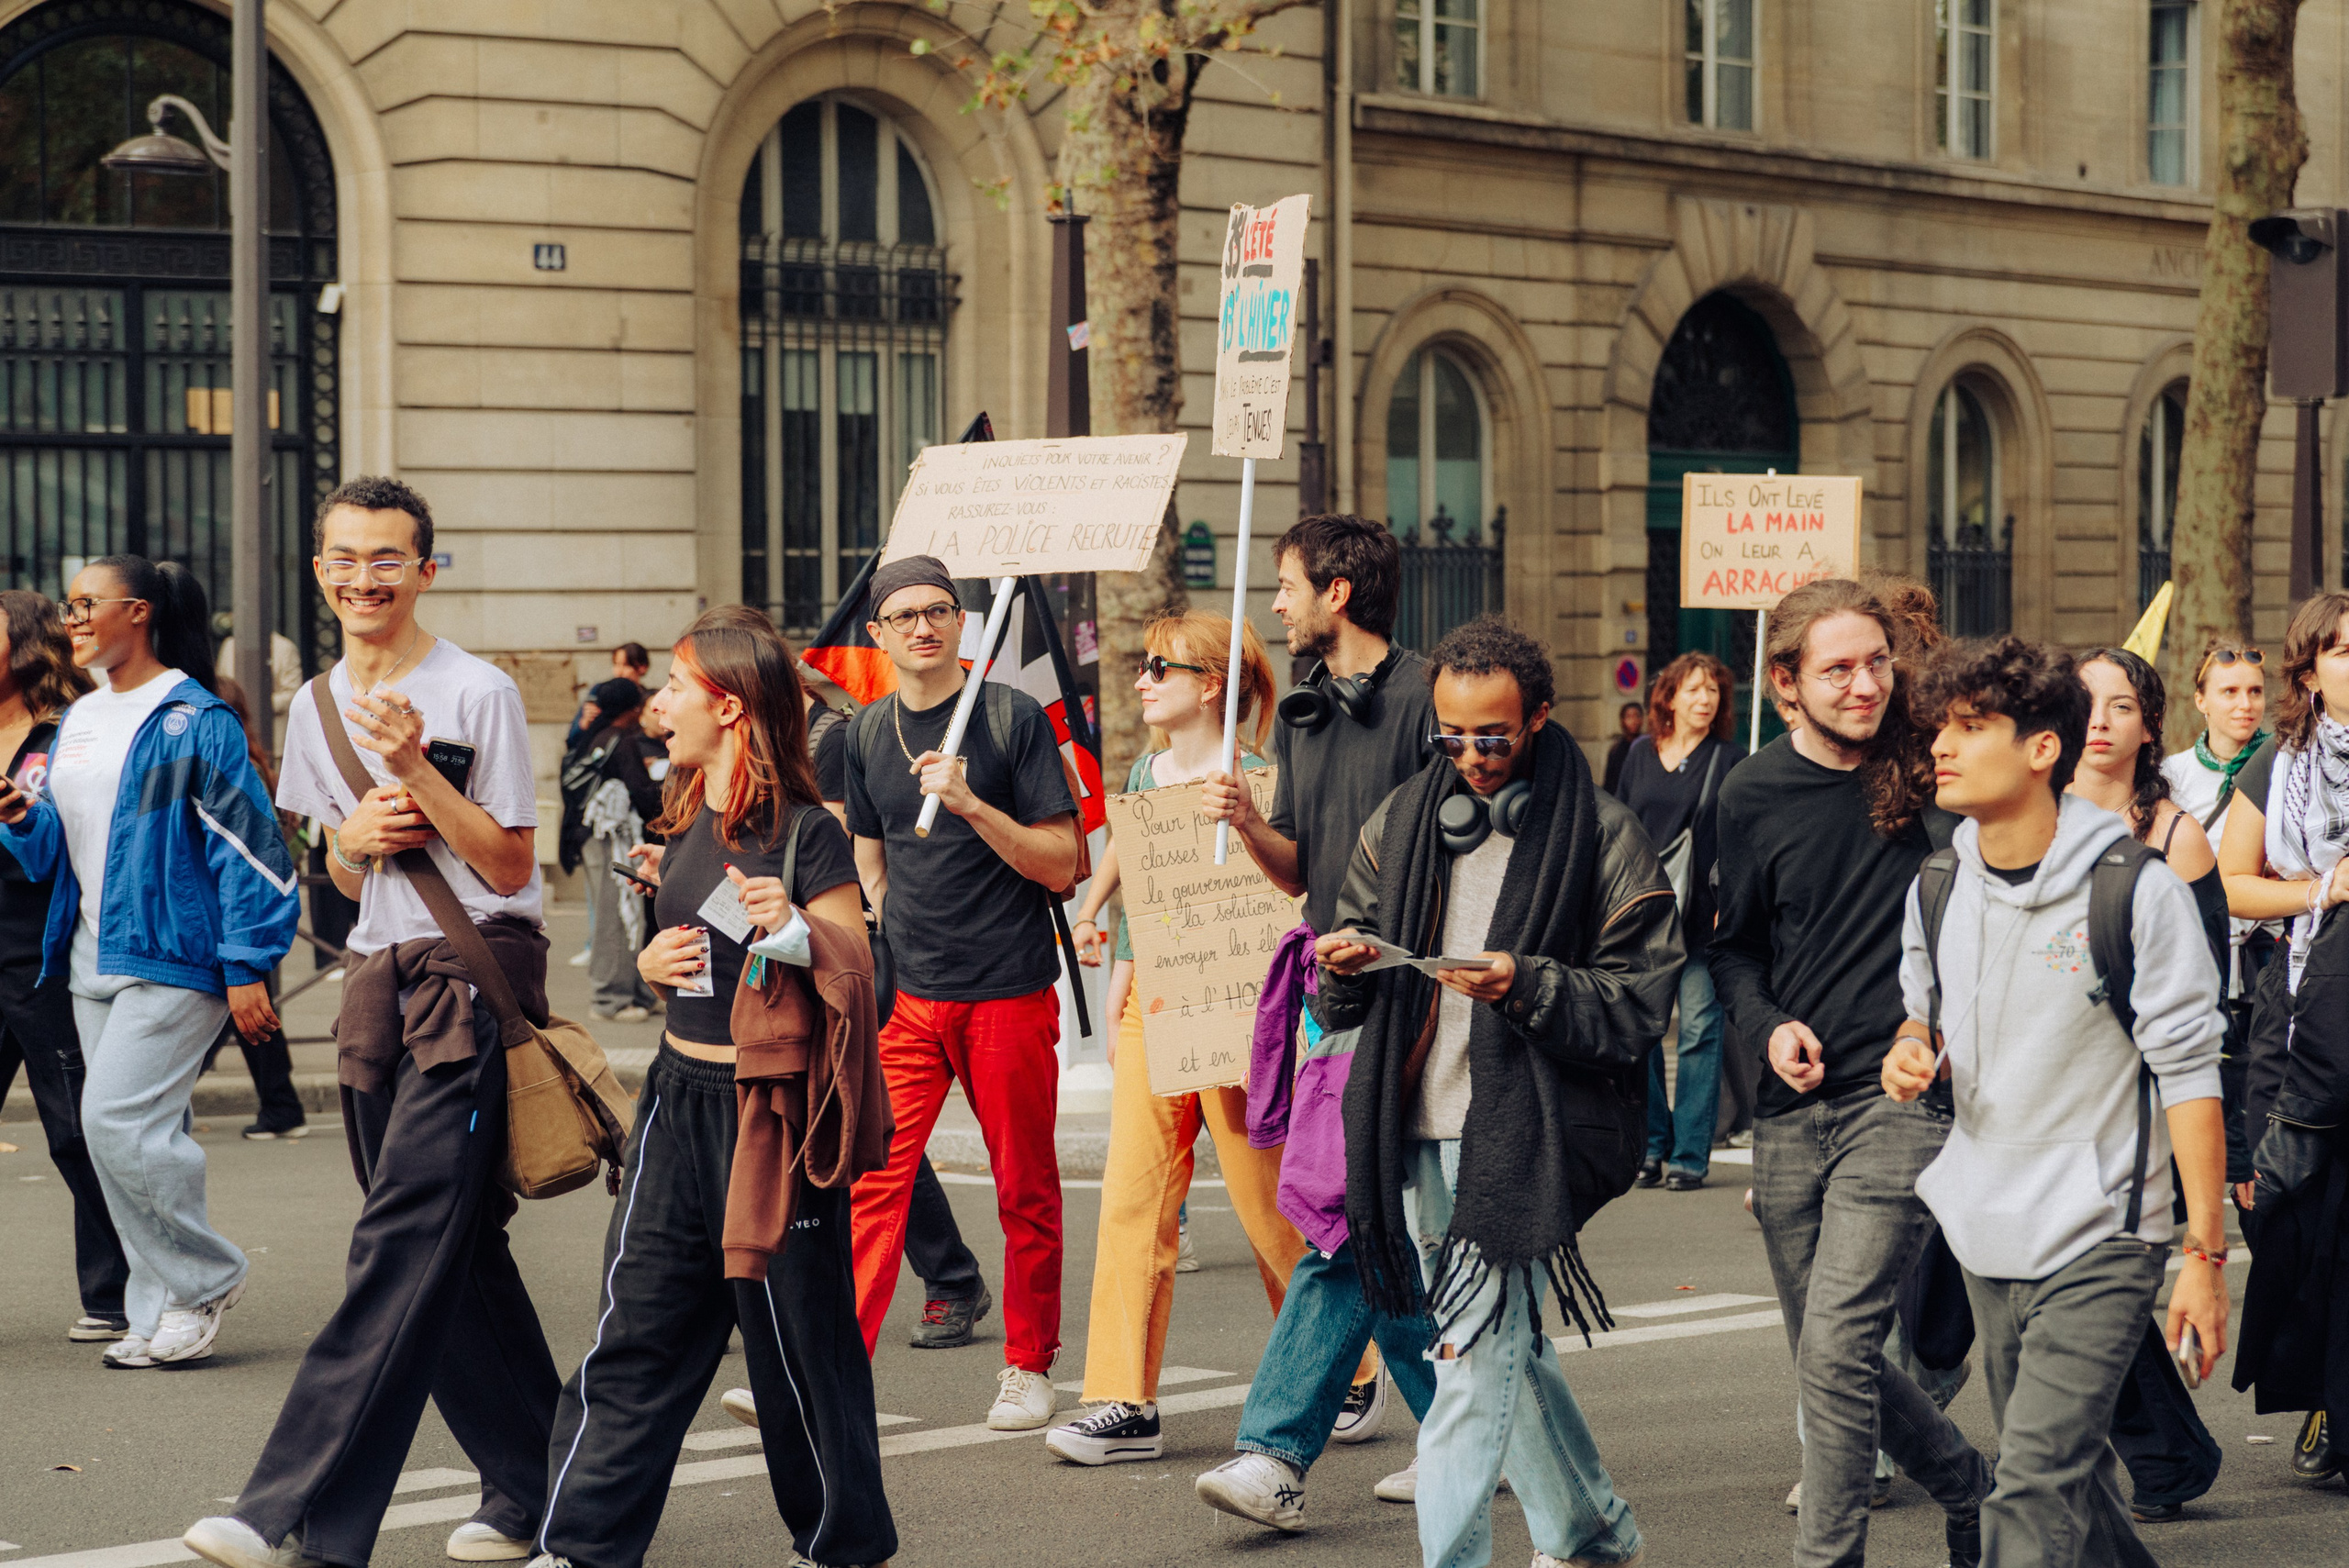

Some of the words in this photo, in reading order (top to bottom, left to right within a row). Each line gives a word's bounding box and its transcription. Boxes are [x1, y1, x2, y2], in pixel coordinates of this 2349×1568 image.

[538, 245, 562, 271] 44
[1238, 279, 1290, 350] L'HIVER
[1242, 403, 1273, 442] TENUES
[1045, 452, 1072, 465] POUR
[1078, 453, 1109, 465] VOTRE
[934, 481, 964, 495] VOUS
[973, 477, 1001, 494] ÊTES
[1090, 478, 1108, 491] ET
[1698, 484, 1735, 507] ILS
[1749, 484, 1780, 508] ONT
[1787, 484, 1824, 509] LEVÉ
[1726, 511, 1754, 535] LA
[1765, 511, 1824, 534] MAIN
[925, 530, 961, 557] LA
[977, 520, 1059, 556] POLICE
[1067, 522, 1160, 551] RECRUTE
[1700, 541, 1723, 561] ON
[1742, 541, 1783, 560] LEUR
[1797, 540, 1815, 561] A
[1132, 798, 1186, 839] Pour
[1139, 841, 1199, 873] classes
[1142, 875, 1165, 905] le
[1182, 902, 1206, 929] la
[1154, 947, 1219, 974] envoyer
[1229, 928, 1250, 956] les
[1180, 998, 1194, 1018] à
[1179, 1047, 1200, 1073] et
[1208, 1049, 1236, 1069] en
